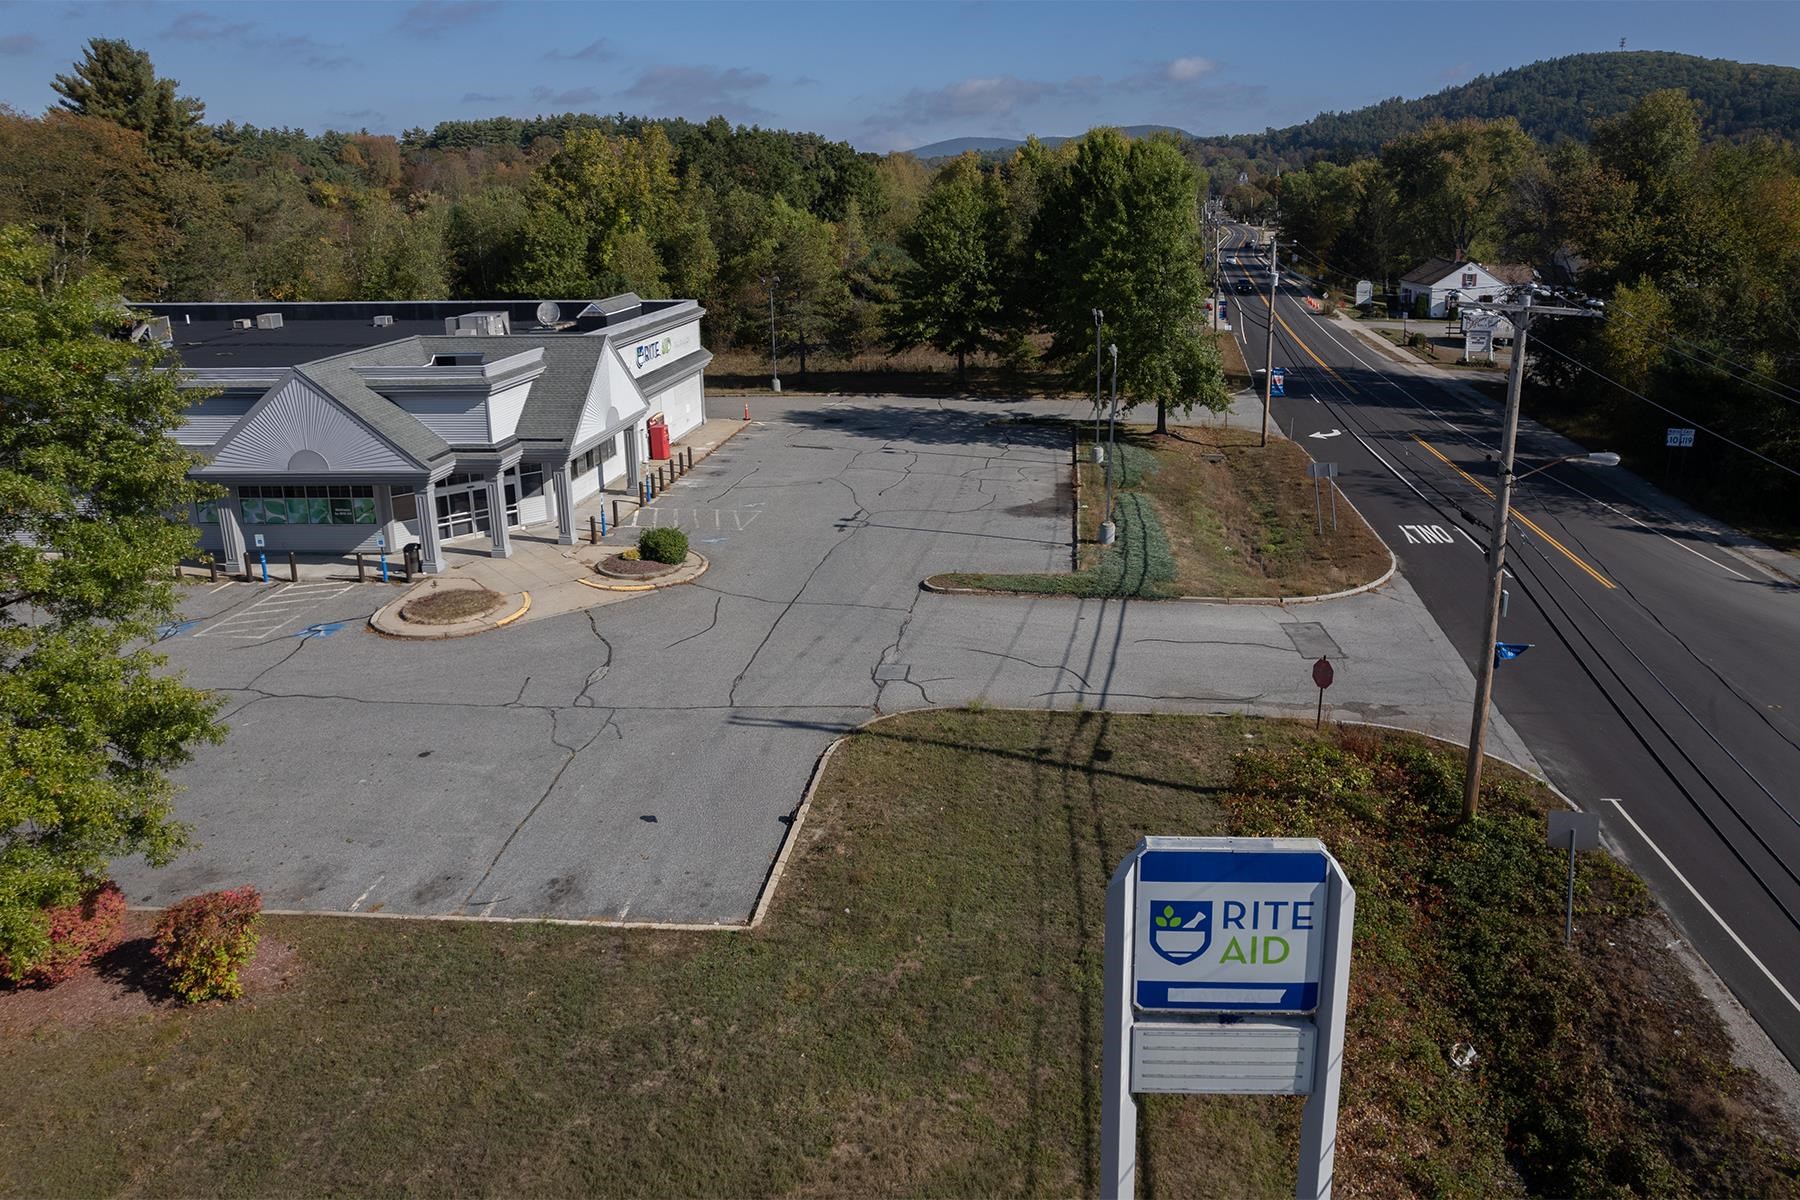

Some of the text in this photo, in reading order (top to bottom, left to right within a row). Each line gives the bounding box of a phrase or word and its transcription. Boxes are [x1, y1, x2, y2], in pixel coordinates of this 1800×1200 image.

[643, 341, 661, 361] RITE
[1670, 436, 1678, 444] 10
[1398, 524, 1454, 544] ONLY
[1222, 901, 1314, 930] RITE
[1218, 935, 1290, 965] AID
